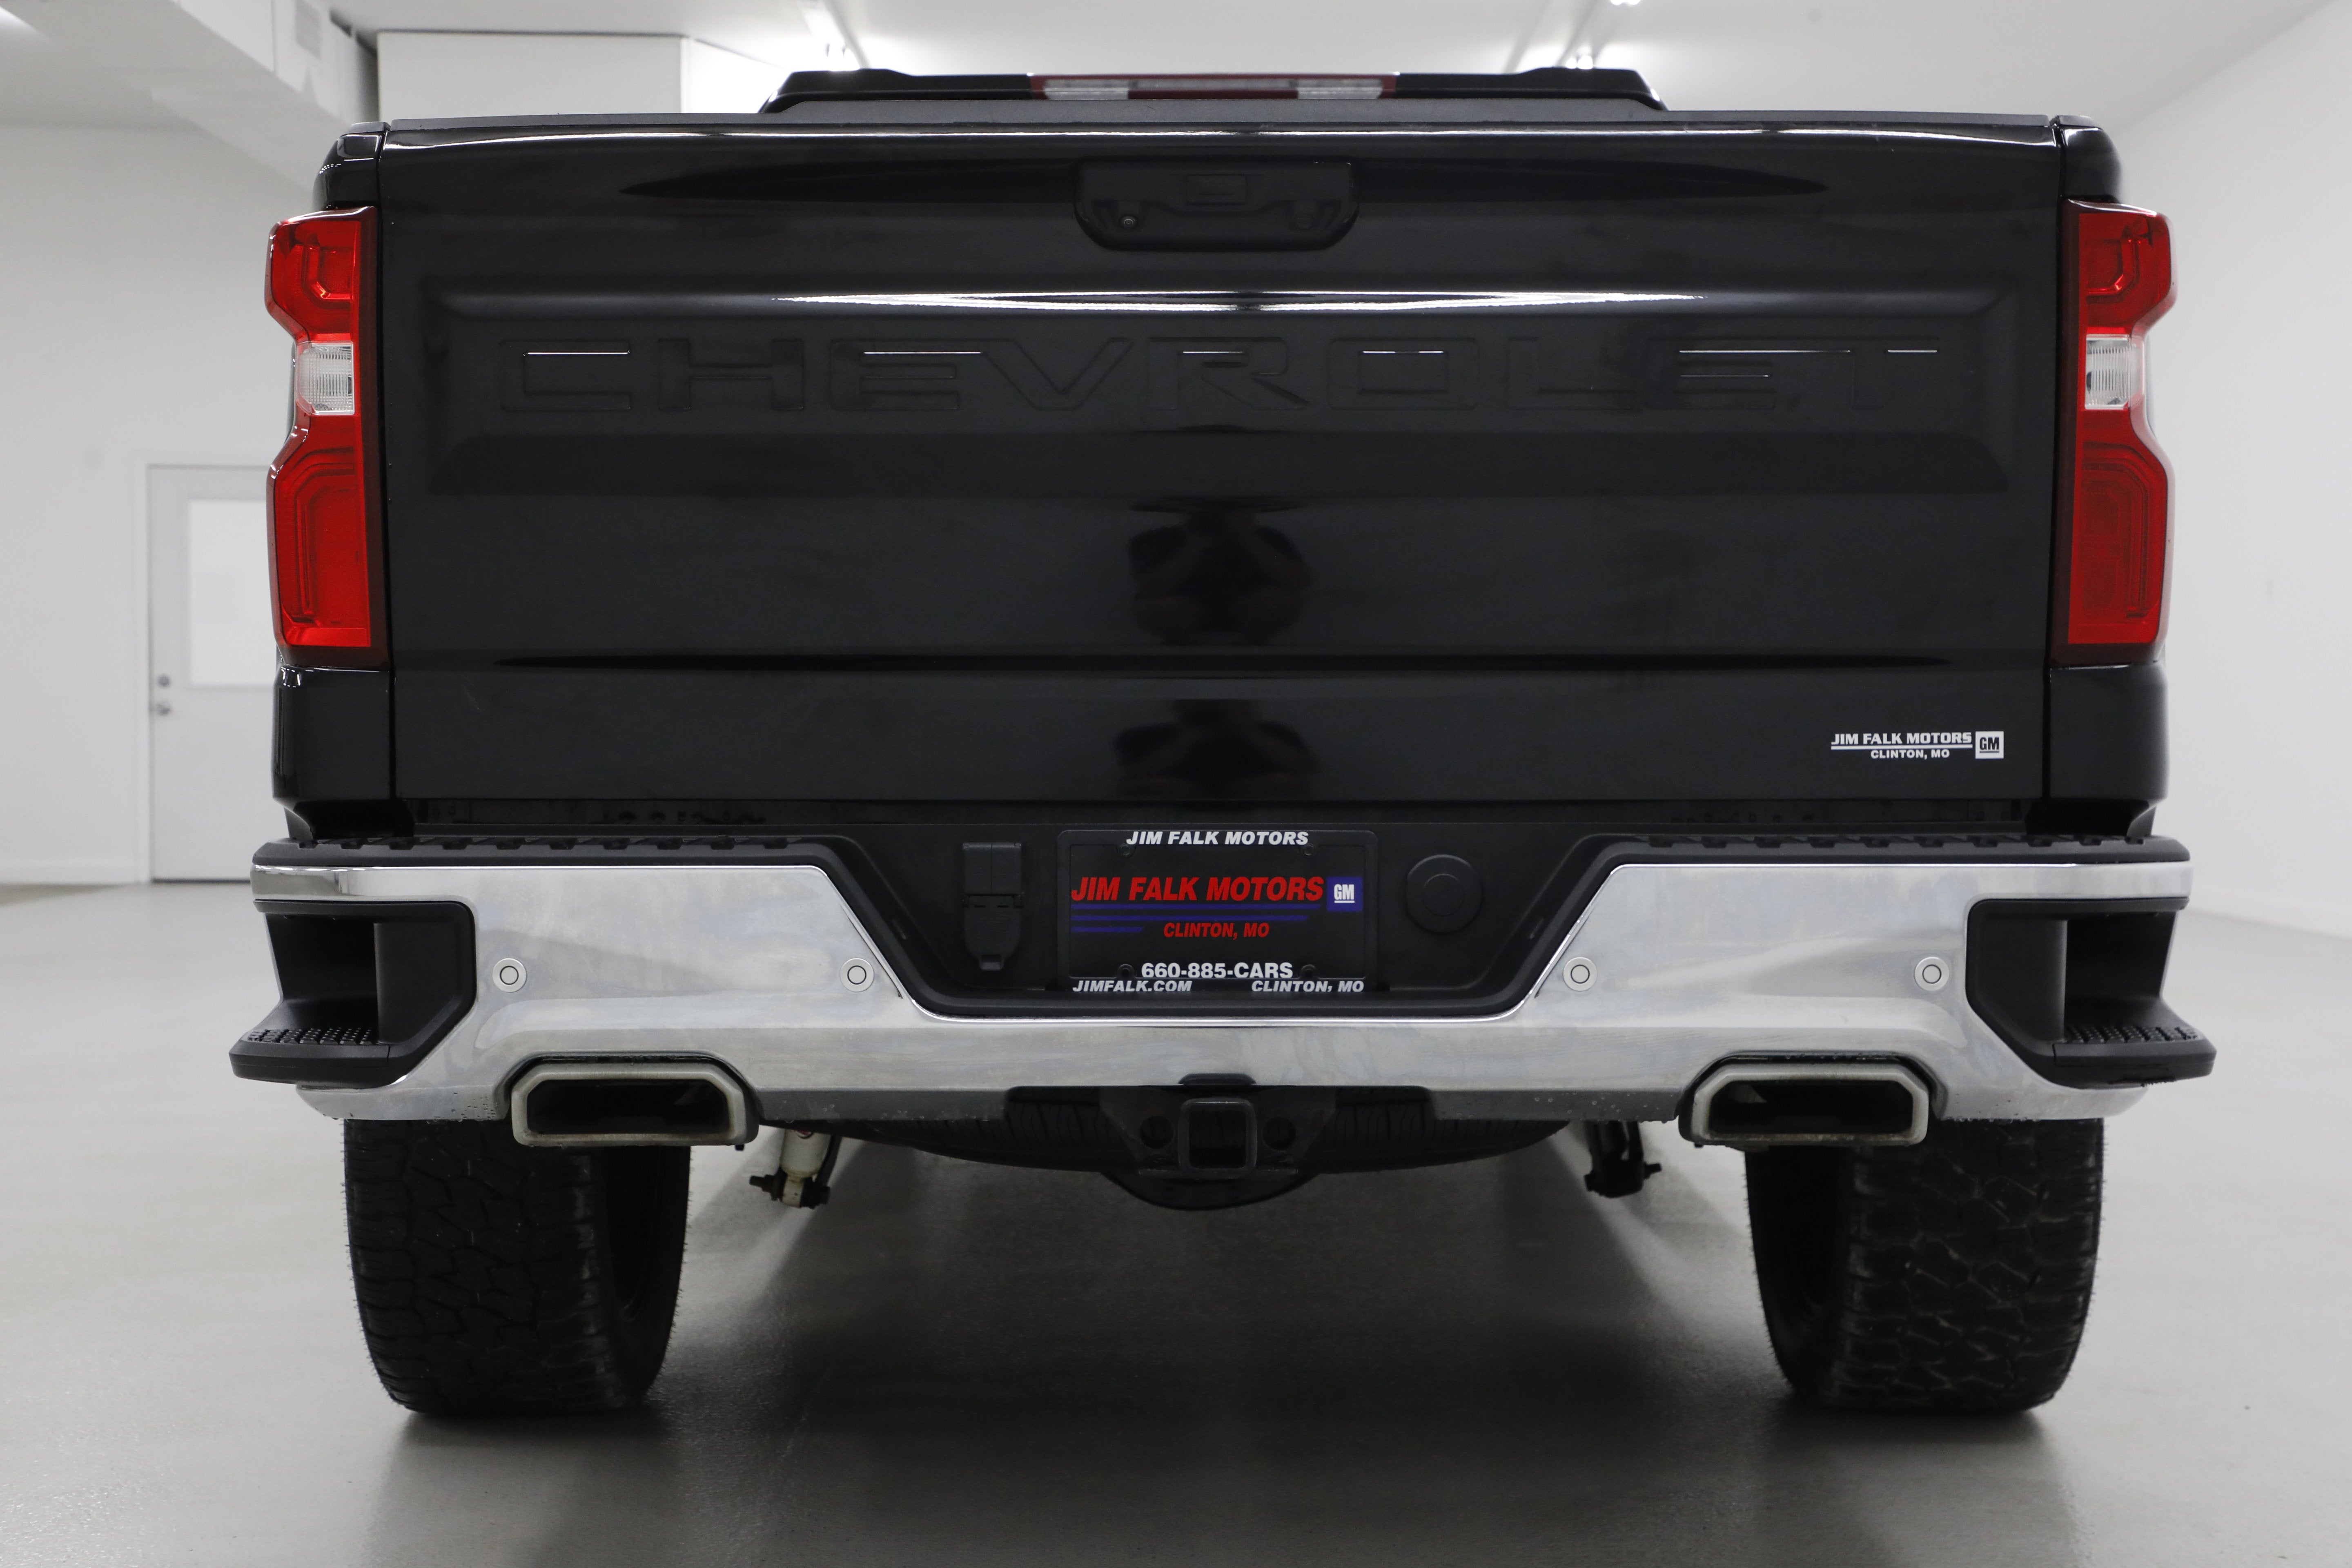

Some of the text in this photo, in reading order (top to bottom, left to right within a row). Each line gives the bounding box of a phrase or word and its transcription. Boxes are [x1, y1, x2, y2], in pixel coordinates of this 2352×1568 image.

[499, 337, 1940, 411] CHEVROLET
[1831, 732, 1972, 745] JIM FALK MOTORS
[1980, 737, 2000, 750] GM
[1871, 749, 1950, 760] CLINTON, MO
[1126, 831, 1309, 845] JIM FALK MOTORS
[1071, 876, 1324, 901] JIM FALK MOTORS
[1334, 884, 1355, 901] GM
[1163, 922, 1270, 940] CLINTON, MO
[1141, 962, 1293, 978] 660-885-CARS
[1072, 980, 1193, 992] JIMFALK.COM
[1252, 980, 1364, 993] CLINTON, MO
